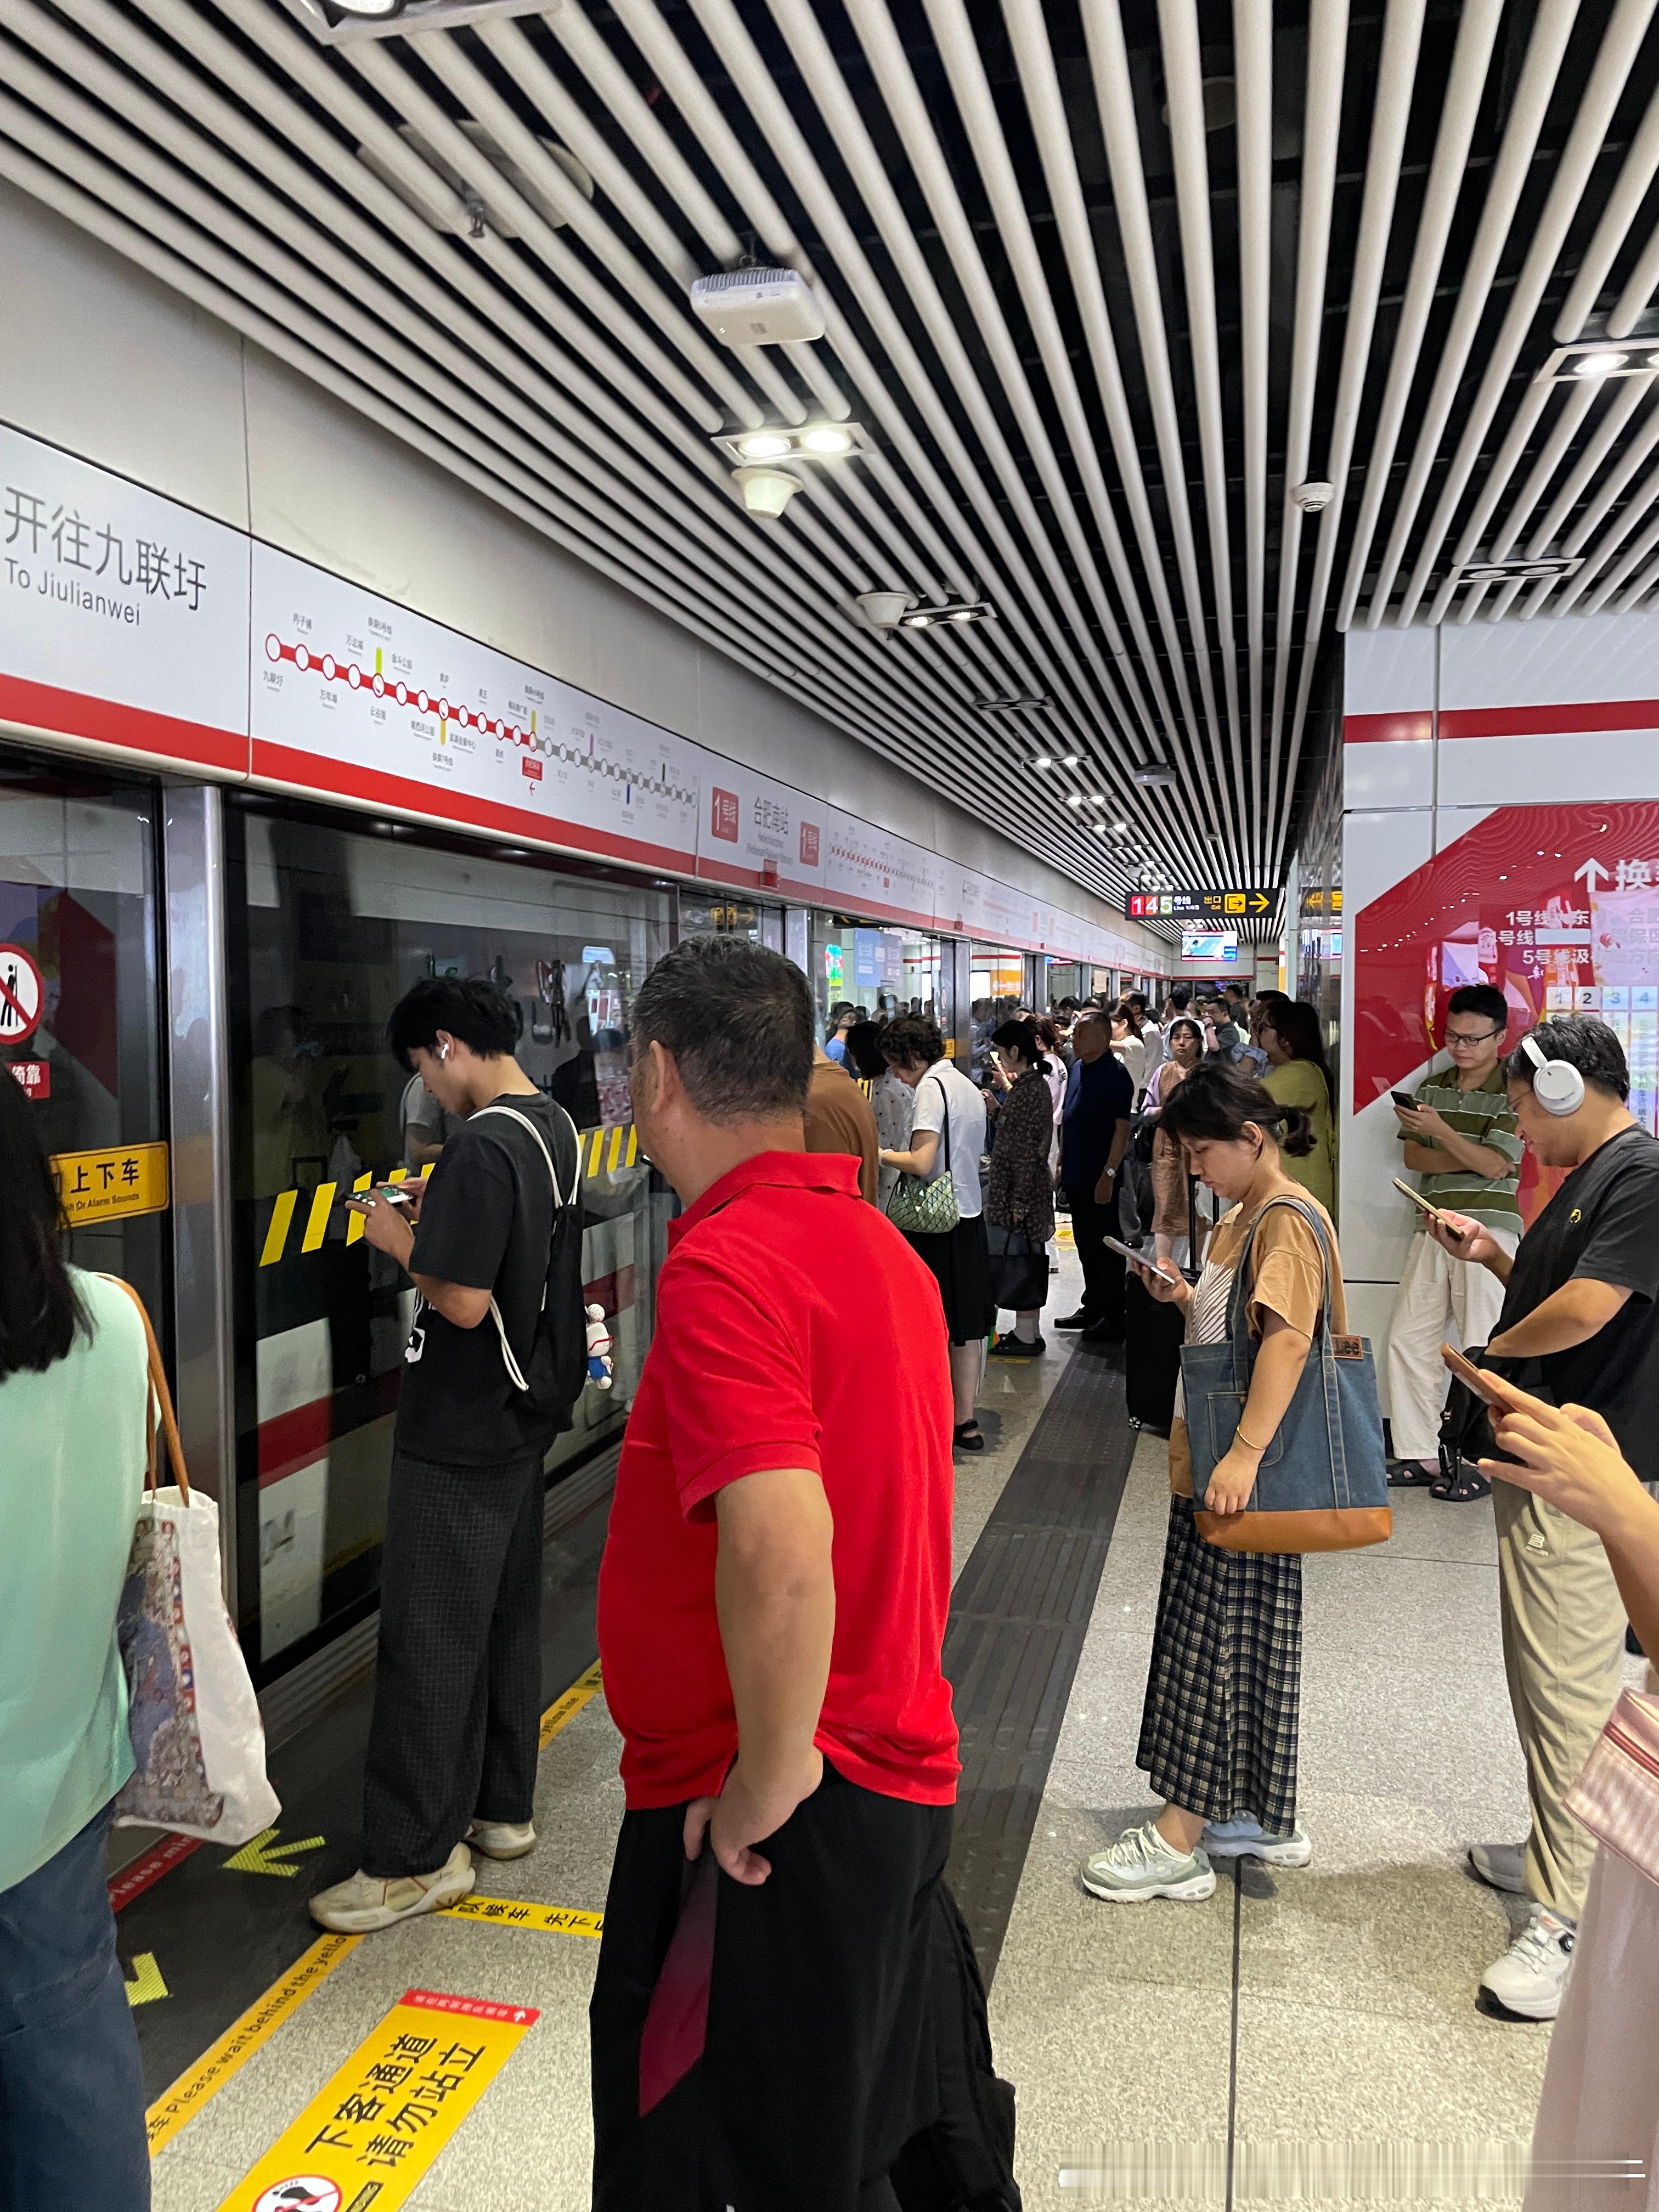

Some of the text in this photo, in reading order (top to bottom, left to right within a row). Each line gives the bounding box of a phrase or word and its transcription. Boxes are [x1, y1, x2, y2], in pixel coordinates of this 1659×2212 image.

[5, 487, 207, 612] 开往九联圩
[5, 557, 140, 625] To Jiulianwei
[754, 795, 789, 834] 合肥南站
[1615, 859, 1659, 892] 换
[1133, 898, 1142, 913] 1
[1146, 898, 1158, 913] 4
[1160, 896, 1172, 913] 5
[1583, 992, 1592, 1004] 2
[1611, 992, 1621, 1004] 3
[1639, 993, 1649, 1003] 4
[70, 1158, 139, 1194] 上下车
[76, 1200, 86, 1212] Or
[87, 1197, 110, 1209] Alarm
[165, 2066, 221, 2115] Please
[216, 2030, 252, 2068] wait
[249, 1988, 296, 2033] behind
[291, 1964, 318, 1989] the
[304, 2033, 438, 2154] 下客通道
[356, 2042, 487, 2168] 请勿站立
